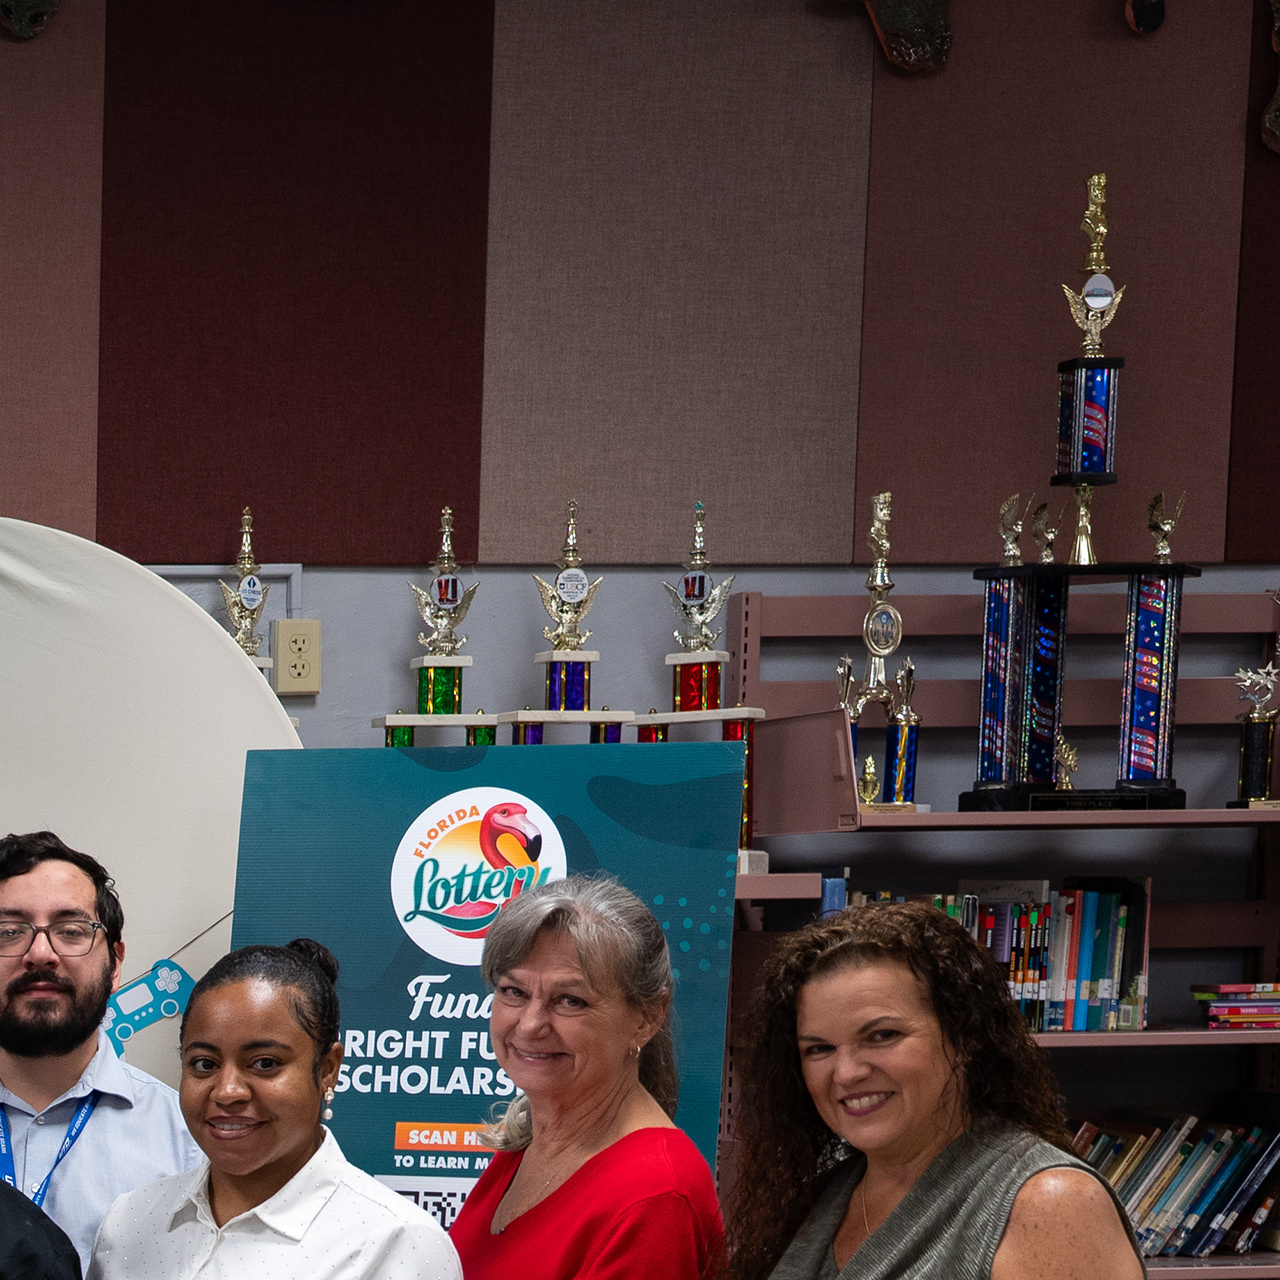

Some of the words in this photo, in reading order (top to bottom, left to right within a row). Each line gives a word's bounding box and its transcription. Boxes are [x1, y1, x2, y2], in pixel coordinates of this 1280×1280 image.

[1065, 800, 1087, 808] FIRST
[1088, 800, 1113, 808] PLACE
[413, 805, 481, 859] FLORIDA
[403, 858, 552, 932] Lottery
[340, 1029, 450, 1059] RIGHT
[334, 1063, 524, 1097] SCHOLARS
[75, 1108, 88, 1131] EDUCATE
[408, 1129, 457, 1146] SCAN
[394, 1155, 414, 1168] TO
[419, 1155, 469, 1170] LEARN
